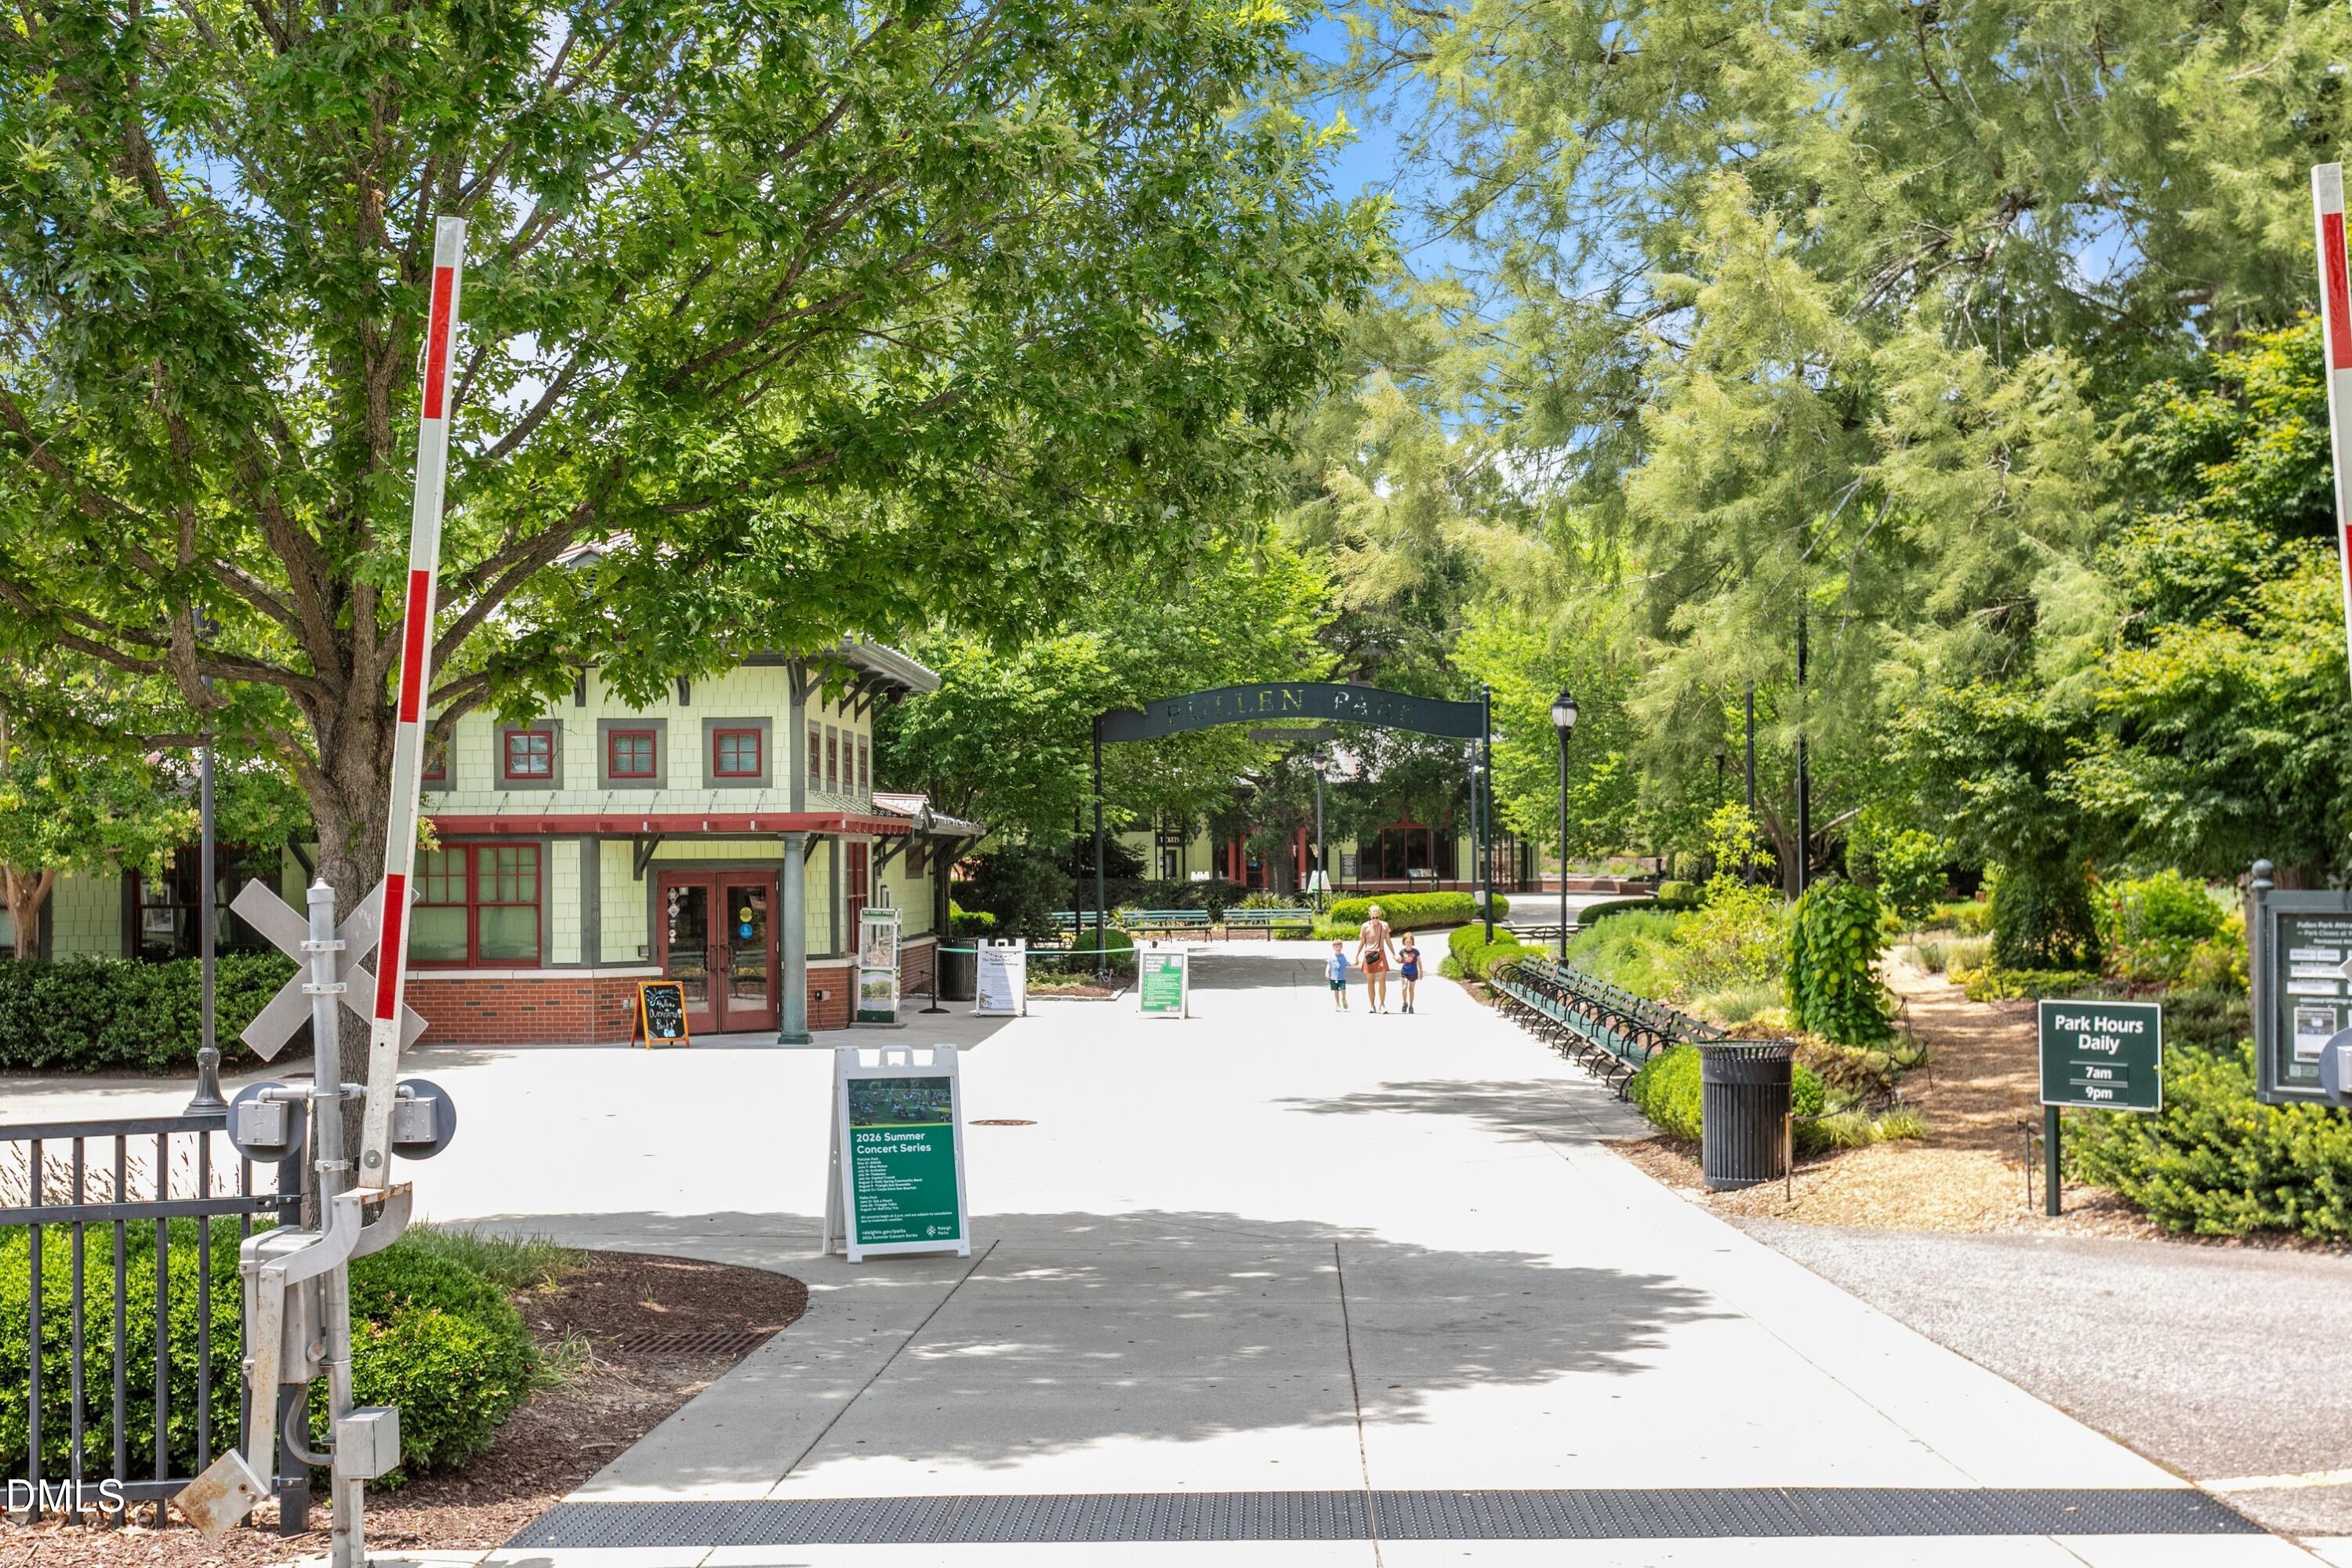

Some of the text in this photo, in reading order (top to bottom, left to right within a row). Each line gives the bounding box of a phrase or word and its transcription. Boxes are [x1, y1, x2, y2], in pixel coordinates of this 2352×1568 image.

[1166, 689, 1305, 728] PULLEN
[2055, 1014, 2143, 1034] Park Hours
[2078, 1033, 2121, 1055] Daily
[2085, 1066, 2113, 1080] 7am
[2085, 1085, 2113, 1102] 9pm
[856, 1132, 925, 1142] 2026 Summer
[857, 1143, 931, 1154] Concert Series
